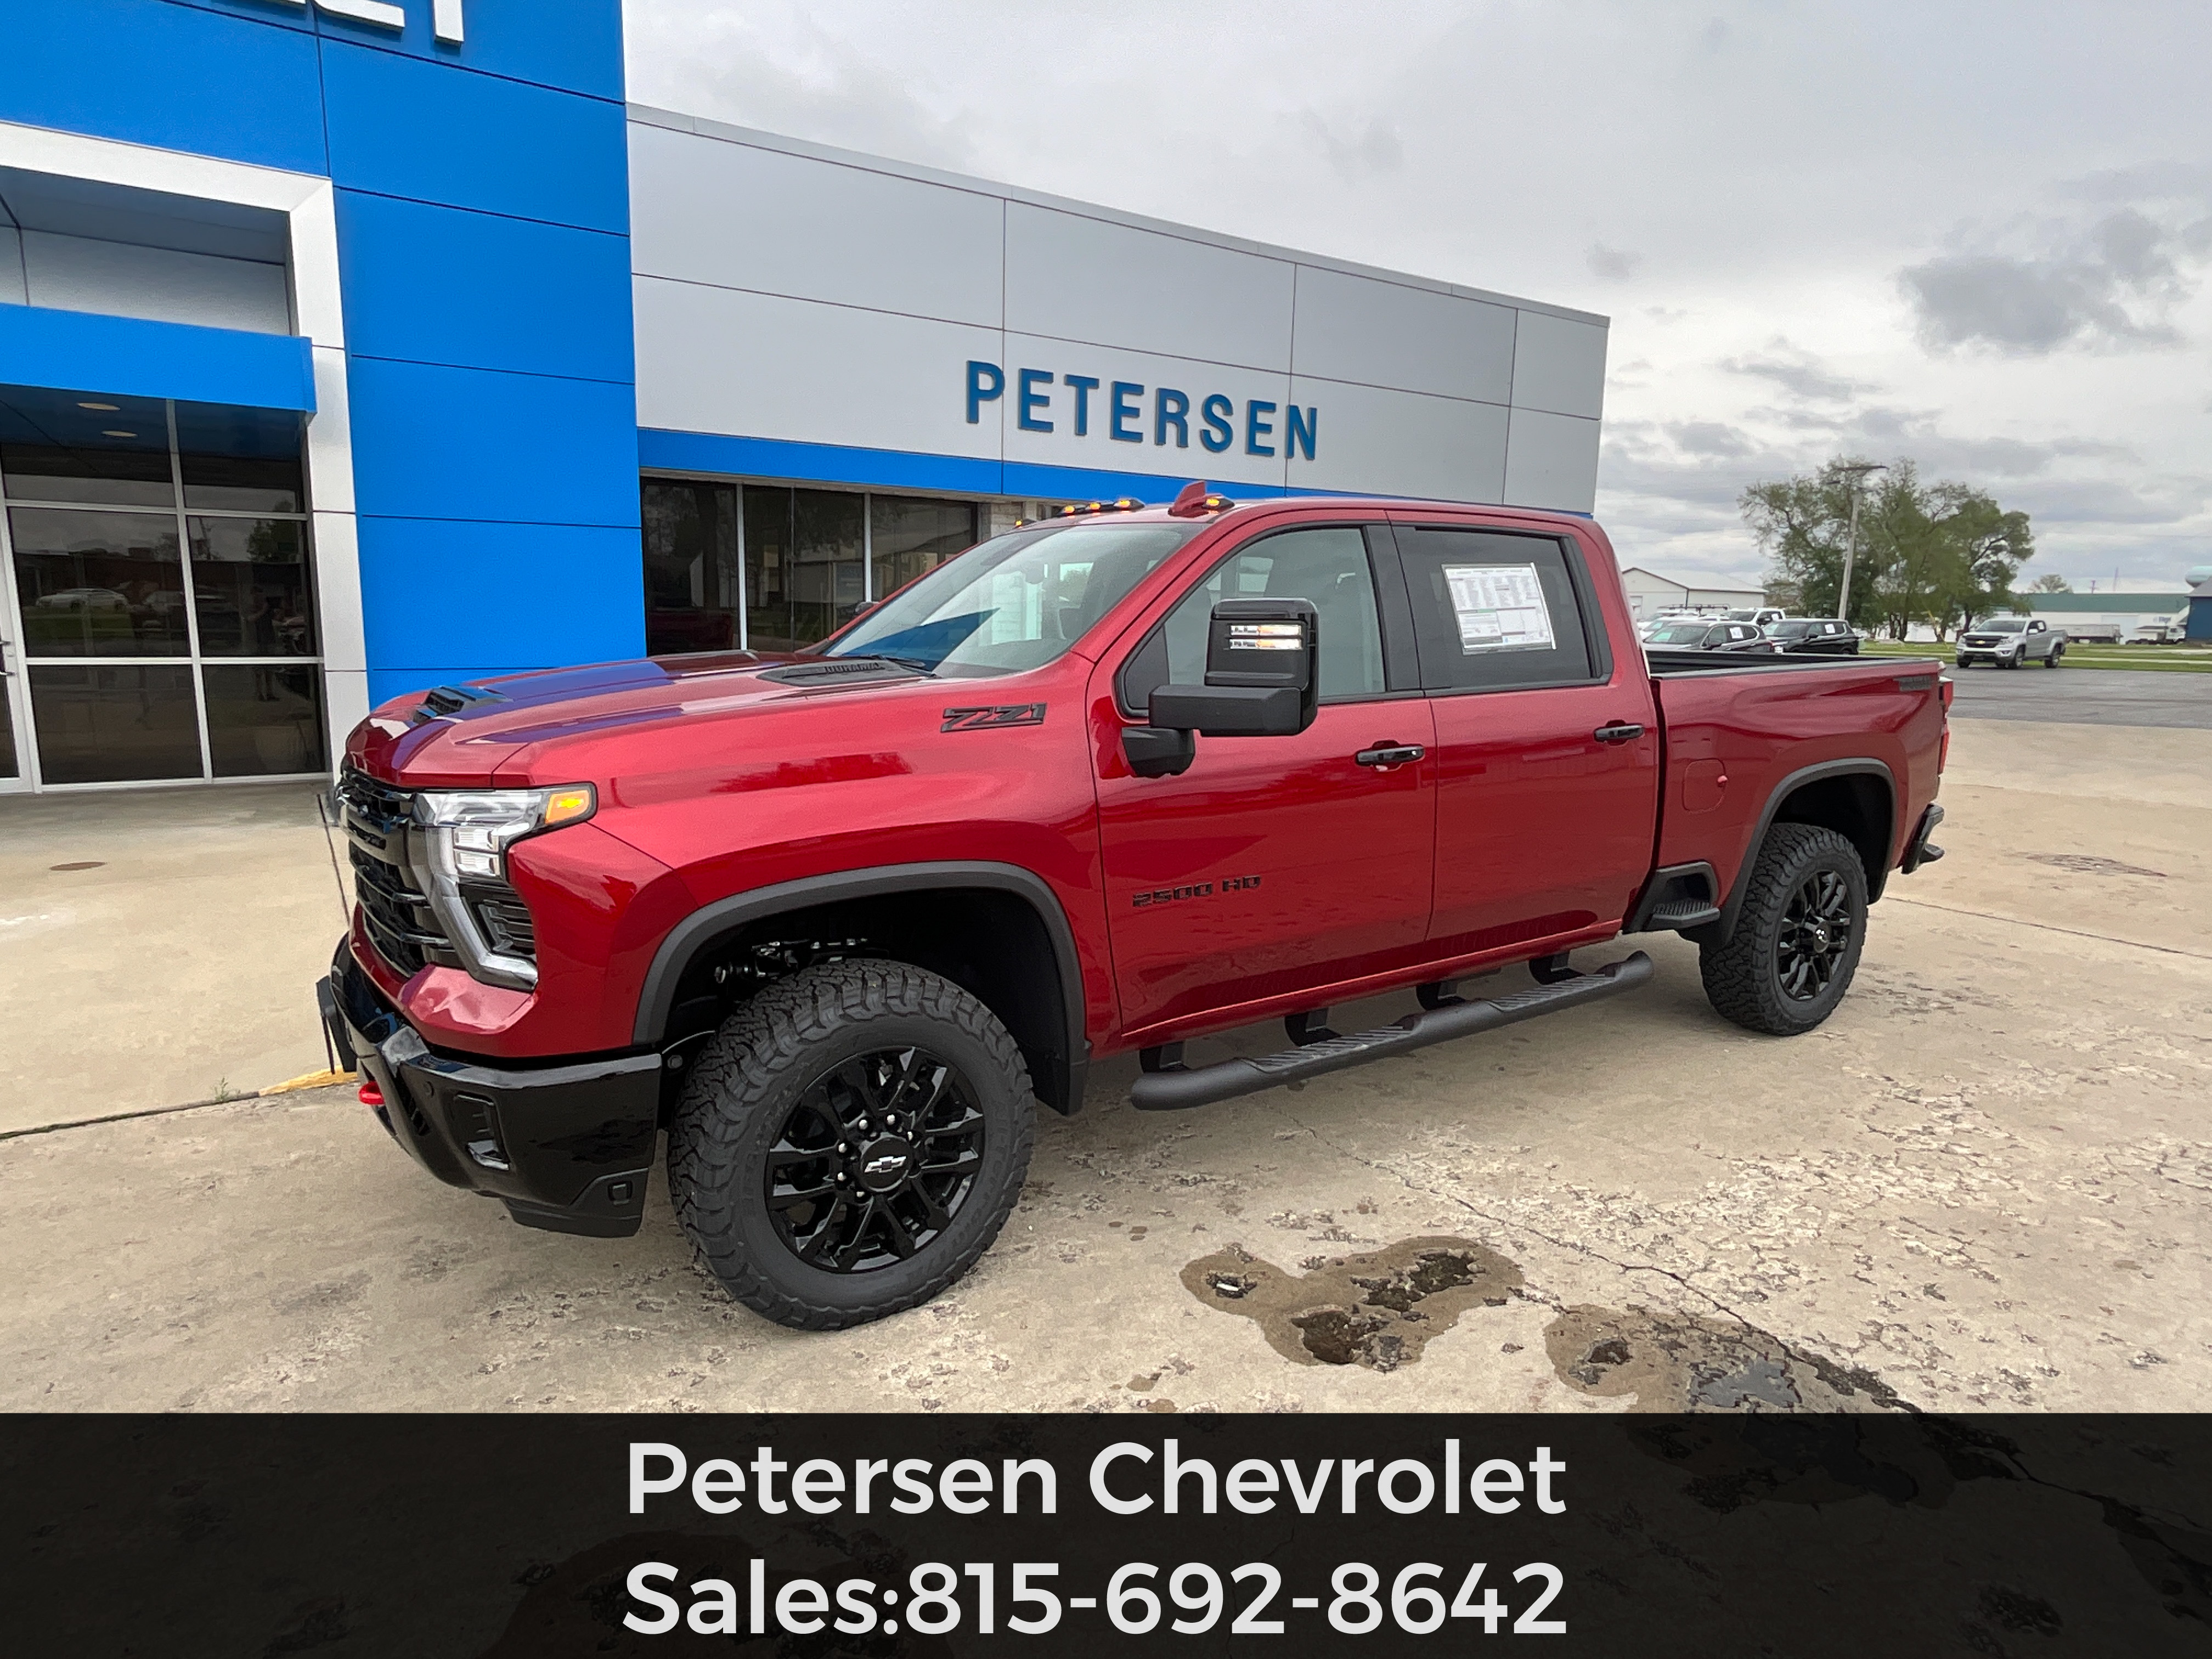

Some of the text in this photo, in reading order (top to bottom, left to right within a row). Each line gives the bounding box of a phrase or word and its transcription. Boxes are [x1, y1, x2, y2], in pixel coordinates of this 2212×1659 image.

[966, 360, 1317, 461] PETERSEN
[1132, 875, 1260, 907] 2500 HD
